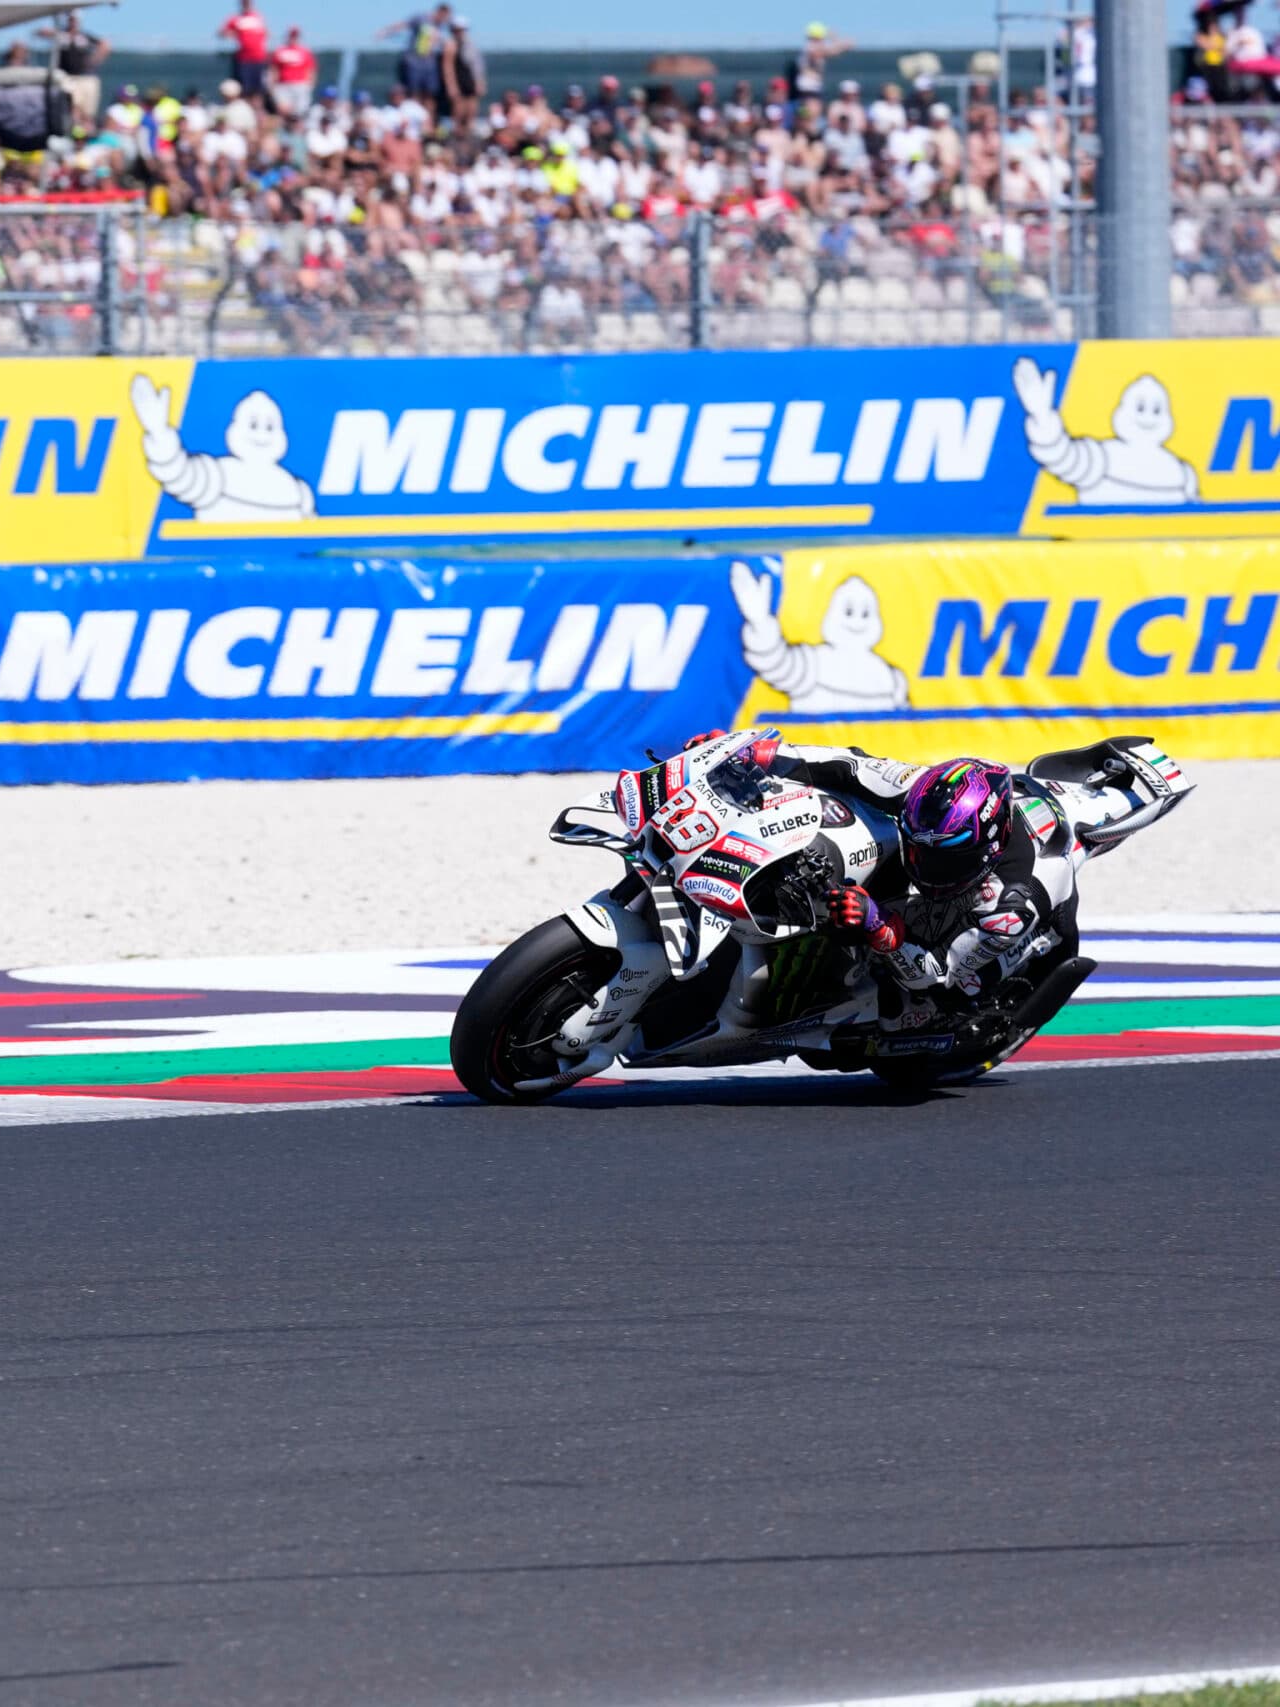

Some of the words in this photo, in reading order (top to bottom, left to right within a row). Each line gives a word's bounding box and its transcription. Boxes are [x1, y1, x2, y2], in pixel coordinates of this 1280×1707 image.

[318, 398, 1004, 494] MICHELIN
[623, 775, 640, 828] sterilgarda
[695, 778, 729, 819] TARGA
[723, 837, 764, 861] BS
[848, 840, 884, 868] aprilia
[699, 855, 740, 873] MONSTER
[684, 877, 736, 902] sterilgarda
[703, 911, 731, 934] sky
